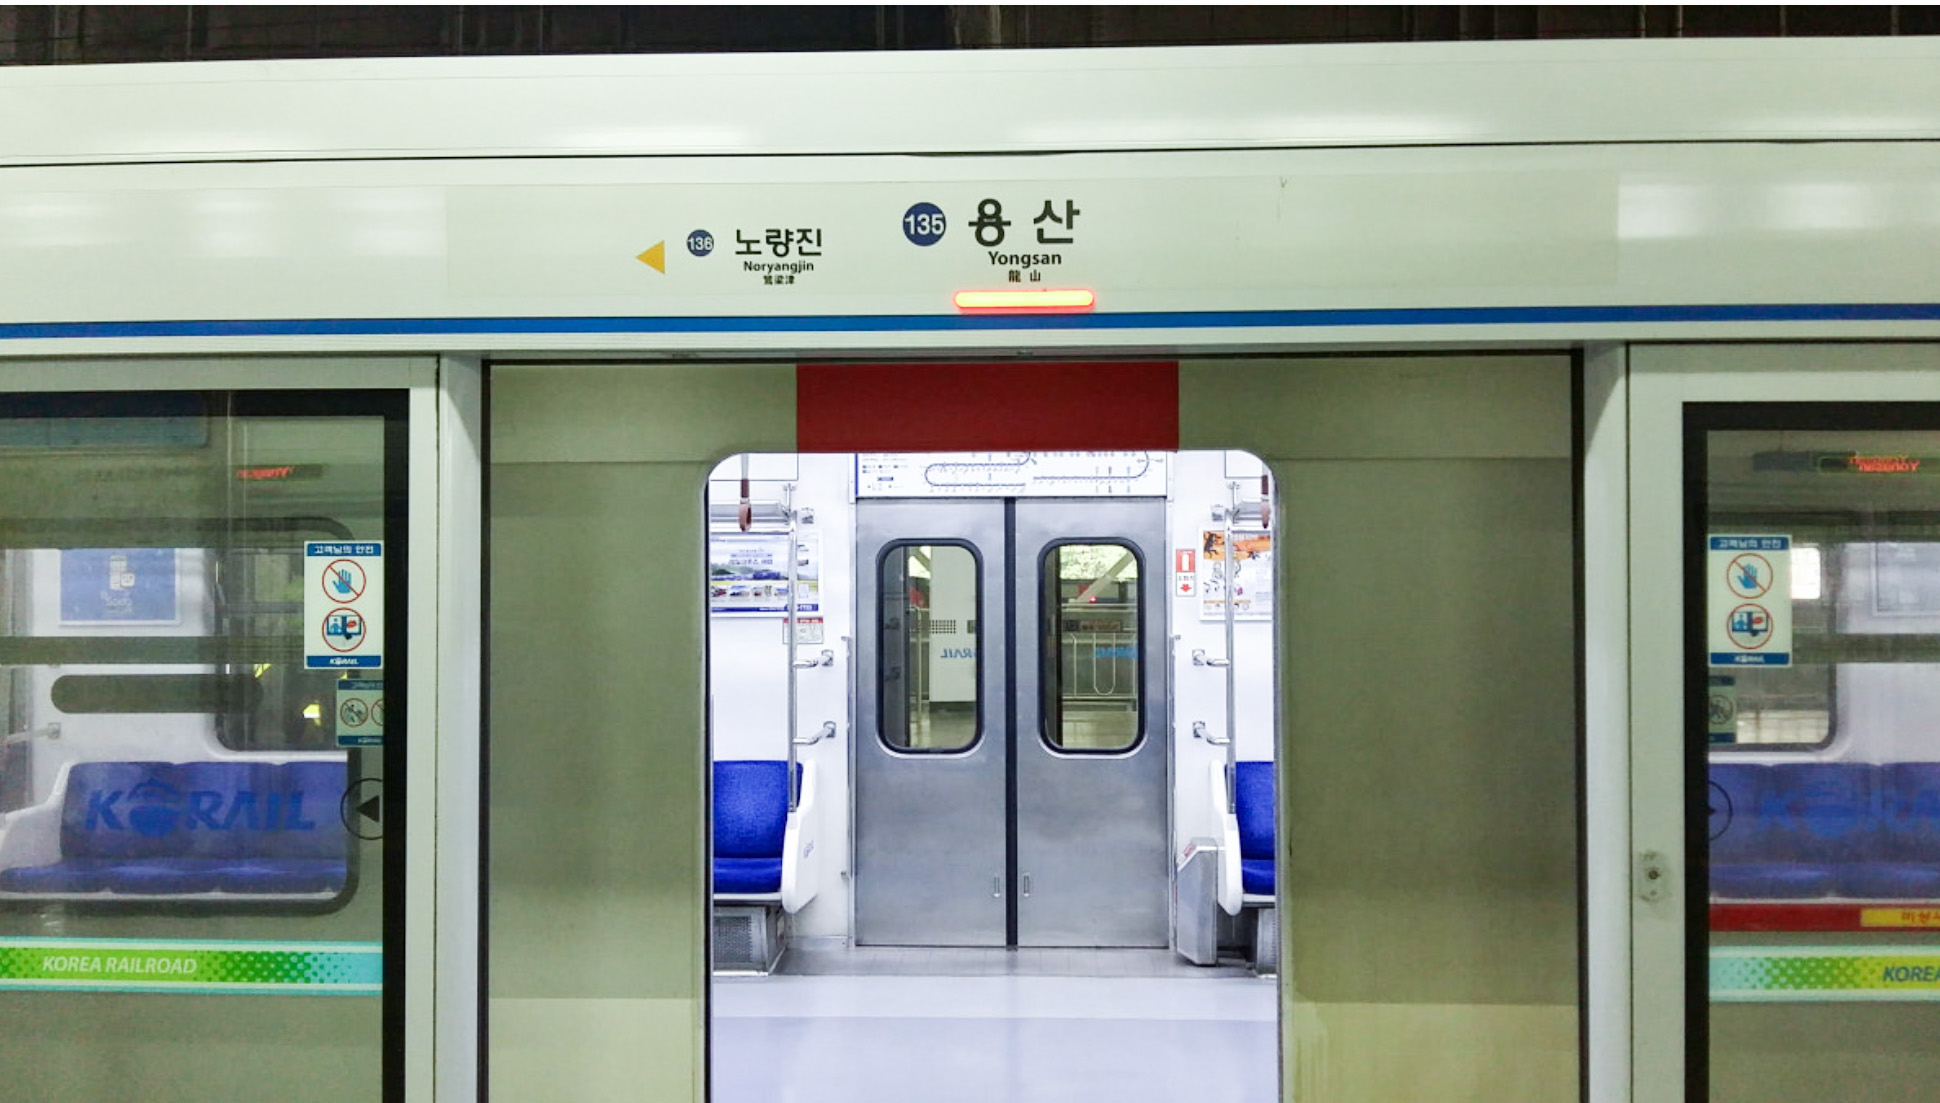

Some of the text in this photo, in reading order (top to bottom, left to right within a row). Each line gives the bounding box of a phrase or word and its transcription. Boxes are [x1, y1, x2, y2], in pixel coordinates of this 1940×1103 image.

[904, 213, 946, 236] 135
[687, 236, 713, 251] 136
[735, 228, 822, 257] 노량진
[743, 260, 814, 274] Noryangjin
[988, 251, 1062, 268] Yongsan
[43, 956, 197, 974] KOREA RAILROAD
